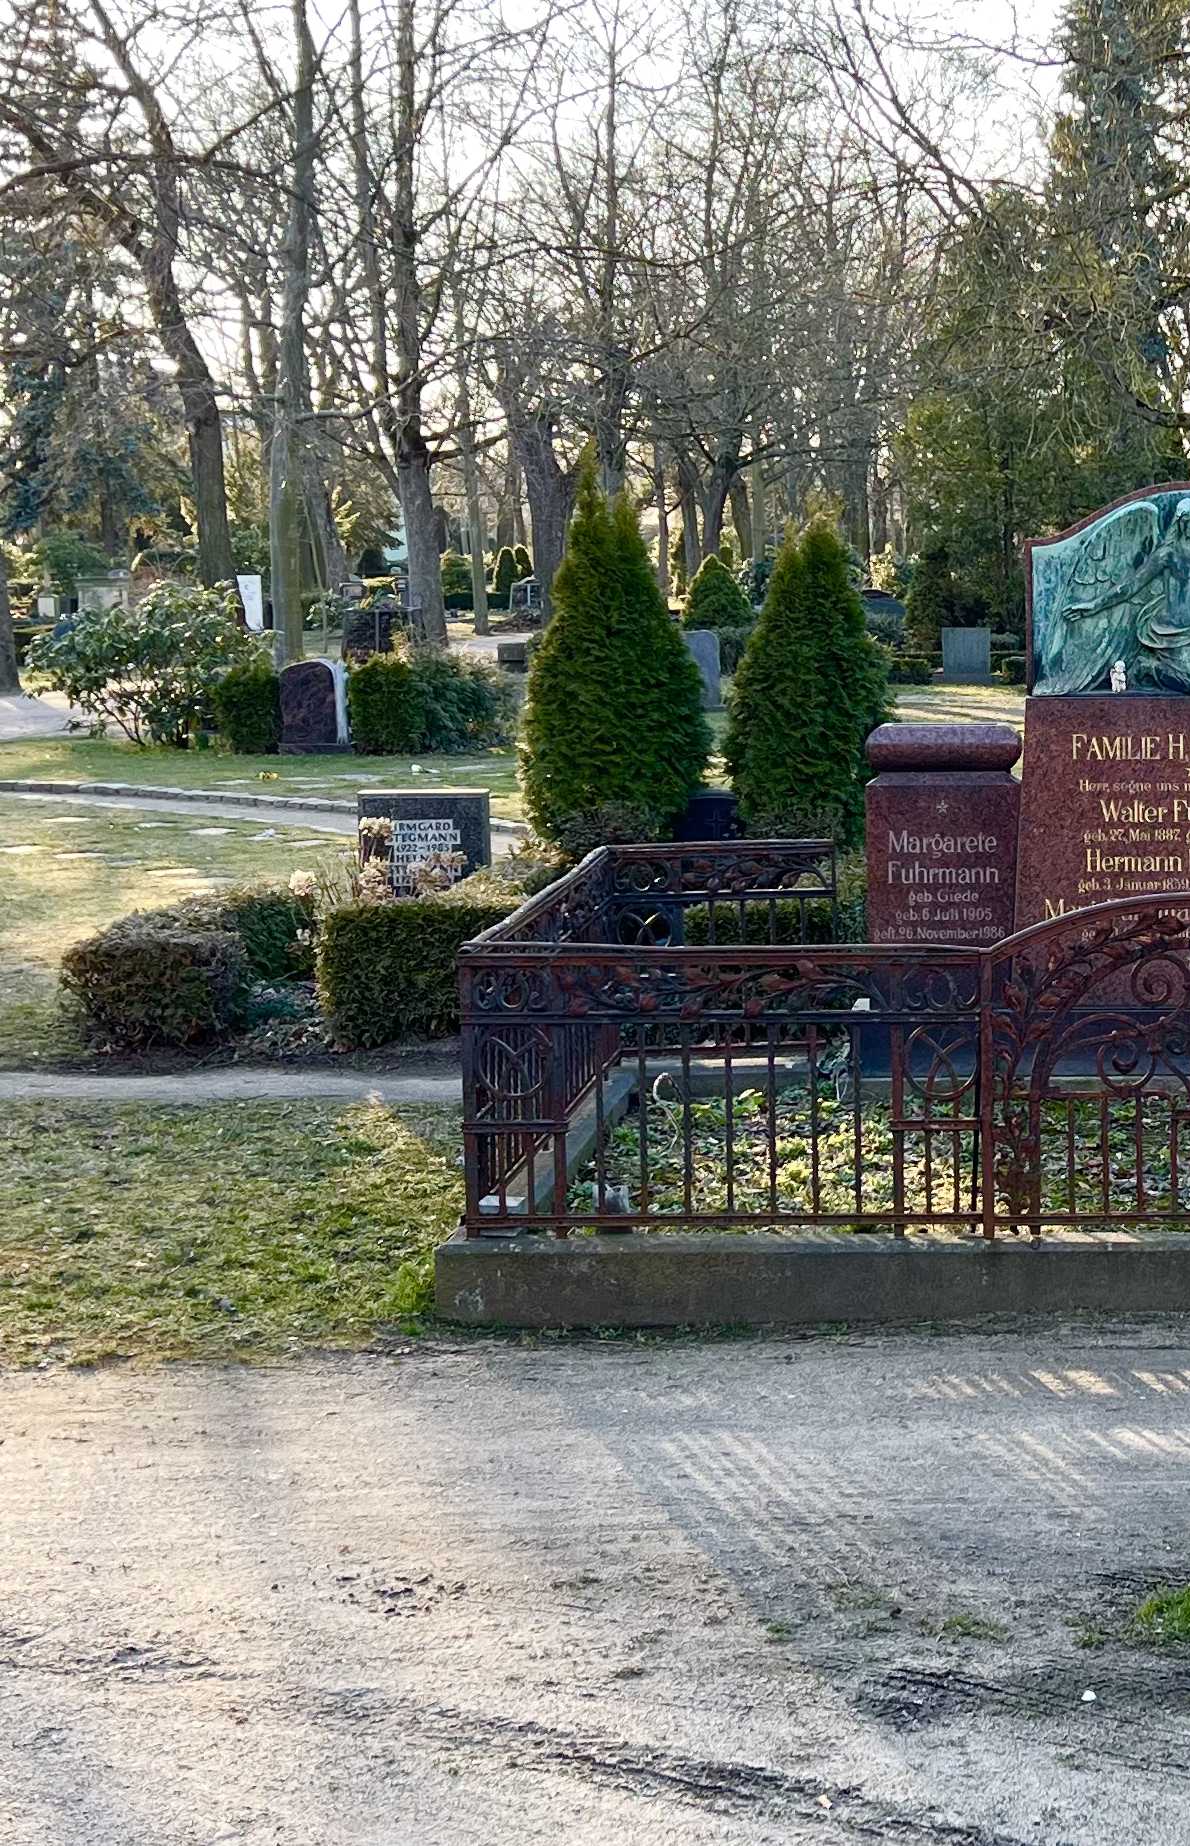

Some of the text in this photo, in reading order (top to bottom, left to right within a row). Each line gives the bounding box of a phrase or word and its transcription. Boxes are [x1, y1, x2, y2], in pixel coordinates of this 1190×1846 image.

[1072, 734, 1160, 760] FAMILIE
[1156, 782, 1180, 792] uns
[1100, 799, 1168, 823] Walter
[394, 822, 451, 831] IRMGARD
[1129, 828, 1151, 841] Mai
[888, 830, 997, 858] Margarete
[1086, 848, 1182, 872] Hermann
[887, 861, 1000, 884] Fuhrmann
[1115, 878, 1159, 891] Januar
[934, 908, 960, 921] Juli
[916, 926, 979, 940] November
[979, 926, 1006, 940] 1986
